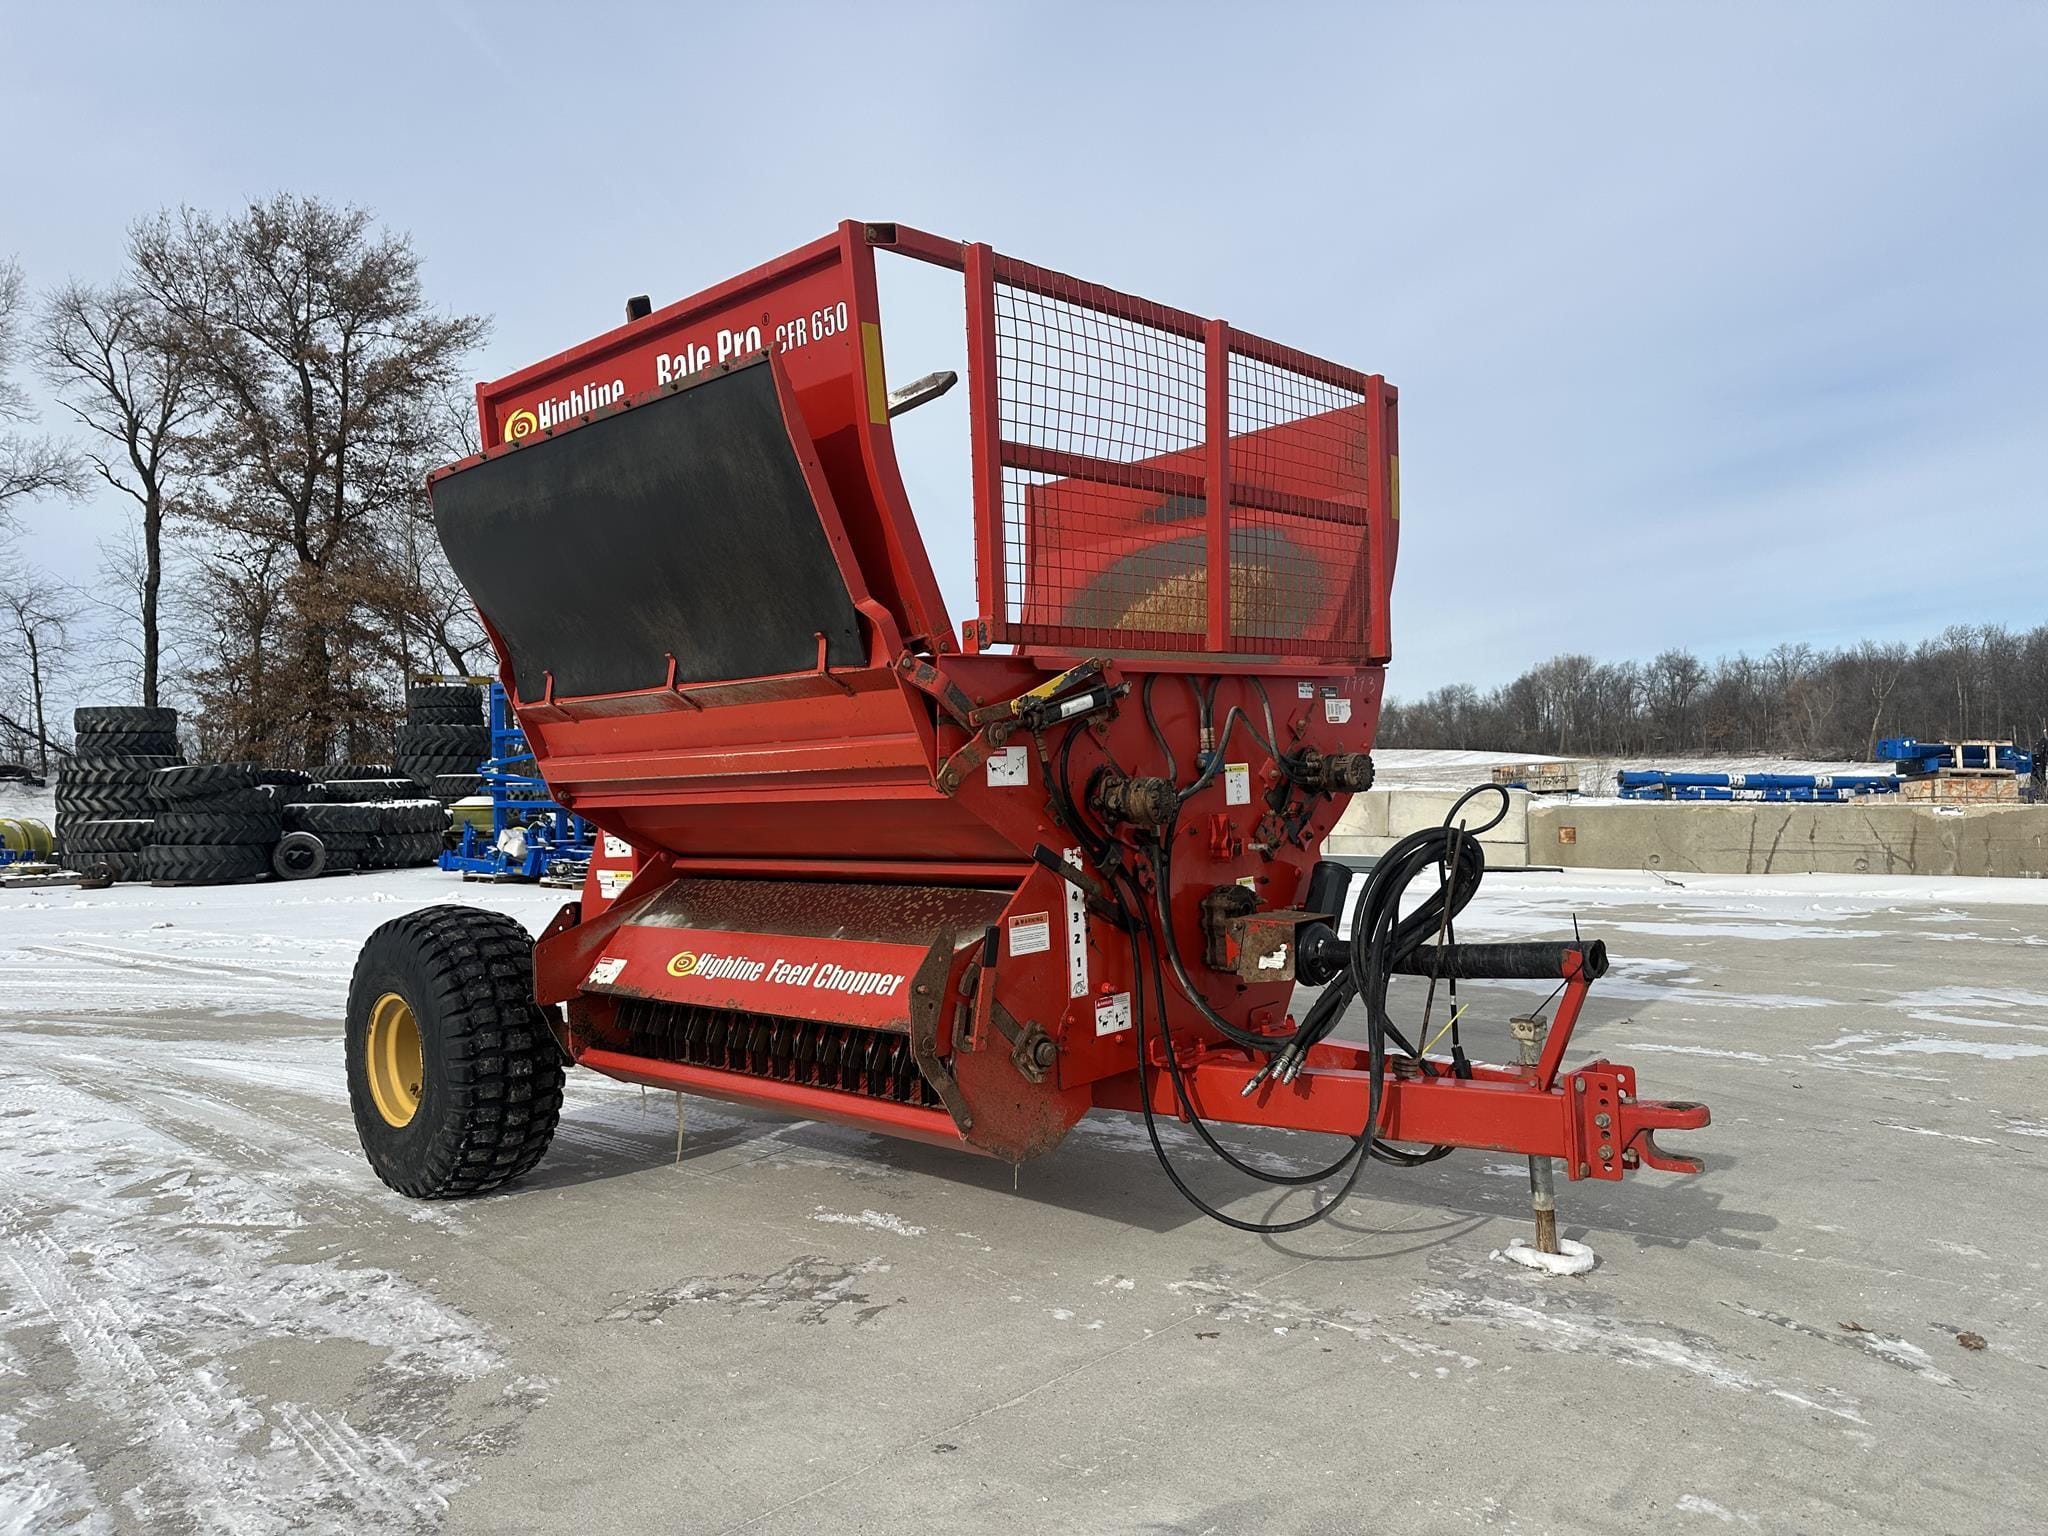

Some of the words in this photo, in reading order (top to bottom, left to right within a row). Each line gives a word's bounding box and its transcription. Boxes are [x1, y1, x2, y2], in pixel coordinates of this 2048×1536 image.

[776, 317, 808, 354] CFR
[811, 301, 849, 341] 650
[656, 342, 712, 386] Bale
[1071, 890, 1079, 901] 4
[1019, 915, 1044, 926] WARNING
[1073, 912, 1080, 923] 3
[1074, 933, 1081, 944] 2
[1076, 957, 1082, 968] 1
[691, 953, 766, 982] Highline
[765, 959, 818, 987] Feed
[813, 963, 905, 997] Chopper
